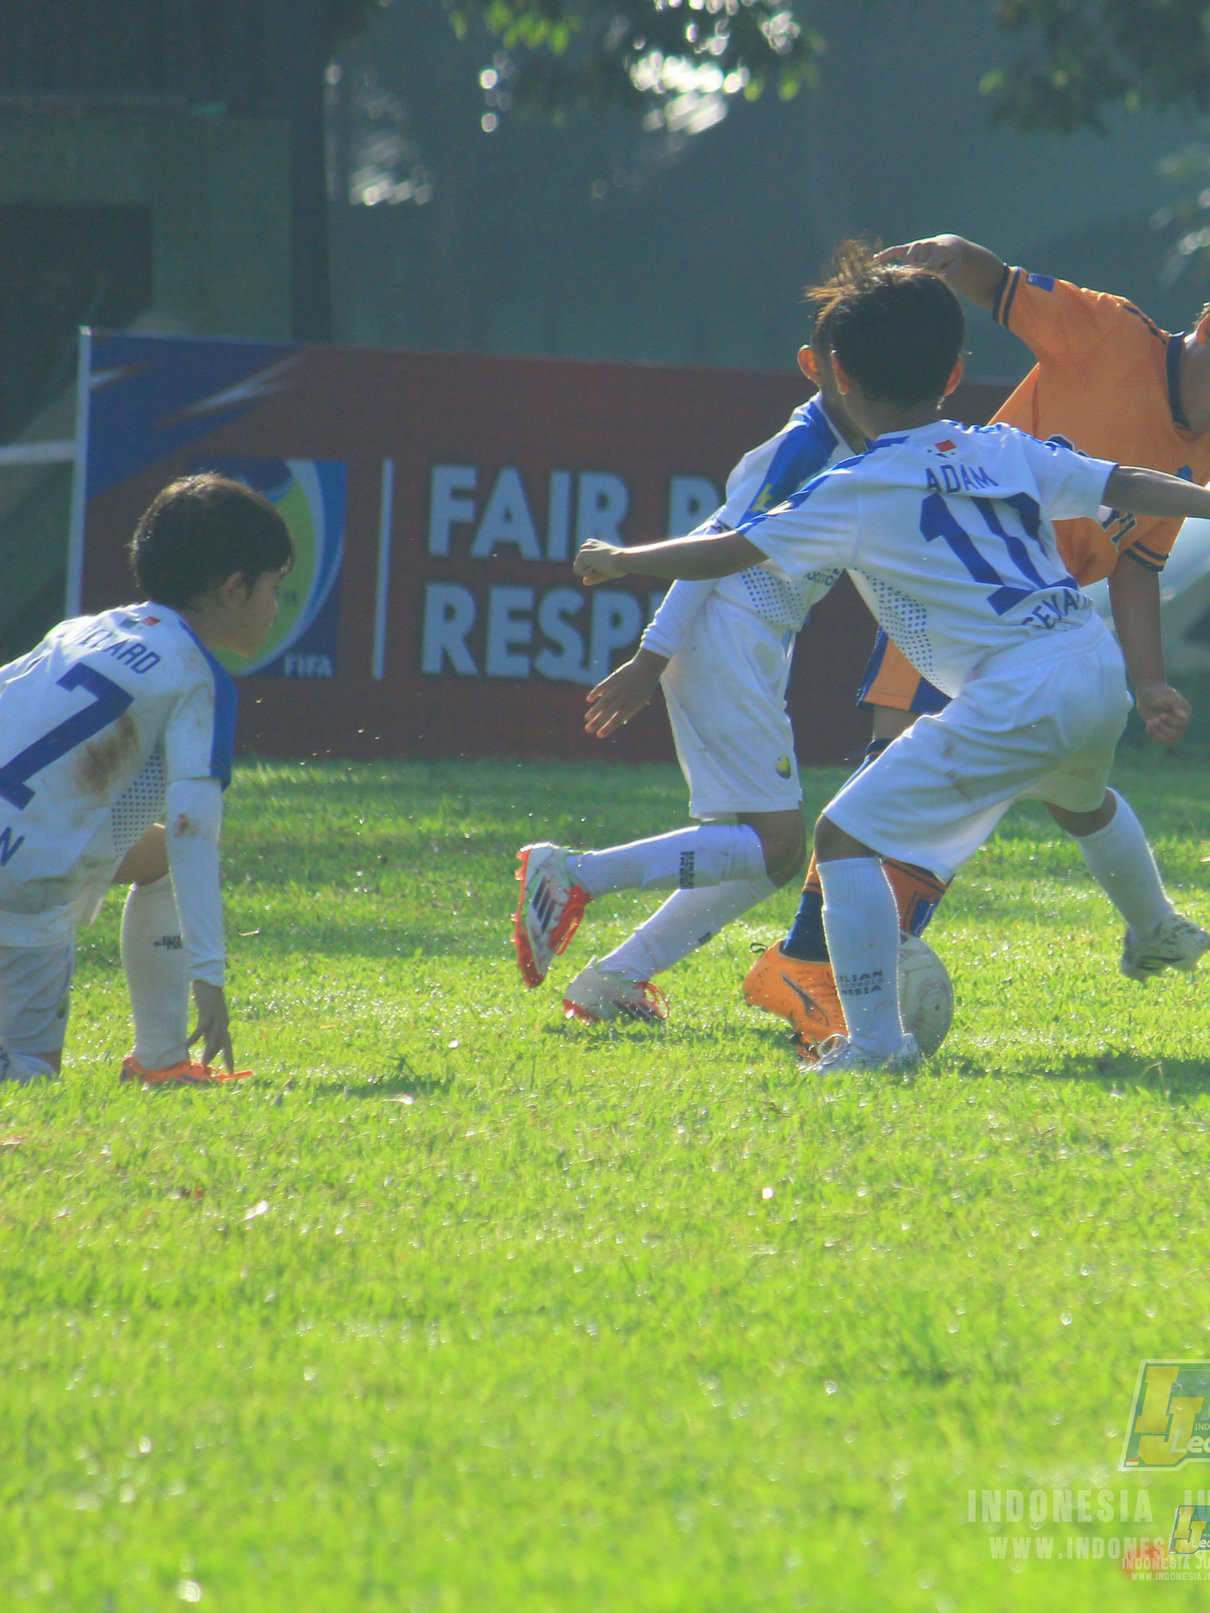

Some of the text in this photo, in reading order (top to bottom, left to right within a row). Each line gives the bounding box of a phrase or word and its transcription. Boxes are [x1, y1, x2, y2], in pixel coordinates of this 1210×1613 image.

[427, 465, 630, 562] FAIR
[925, 464, 999, 493] ADAM
[283, 655, 334, 678] FIFA
[420, 583, 662, 684] RESP
[0, 662, 135, 811] 7
